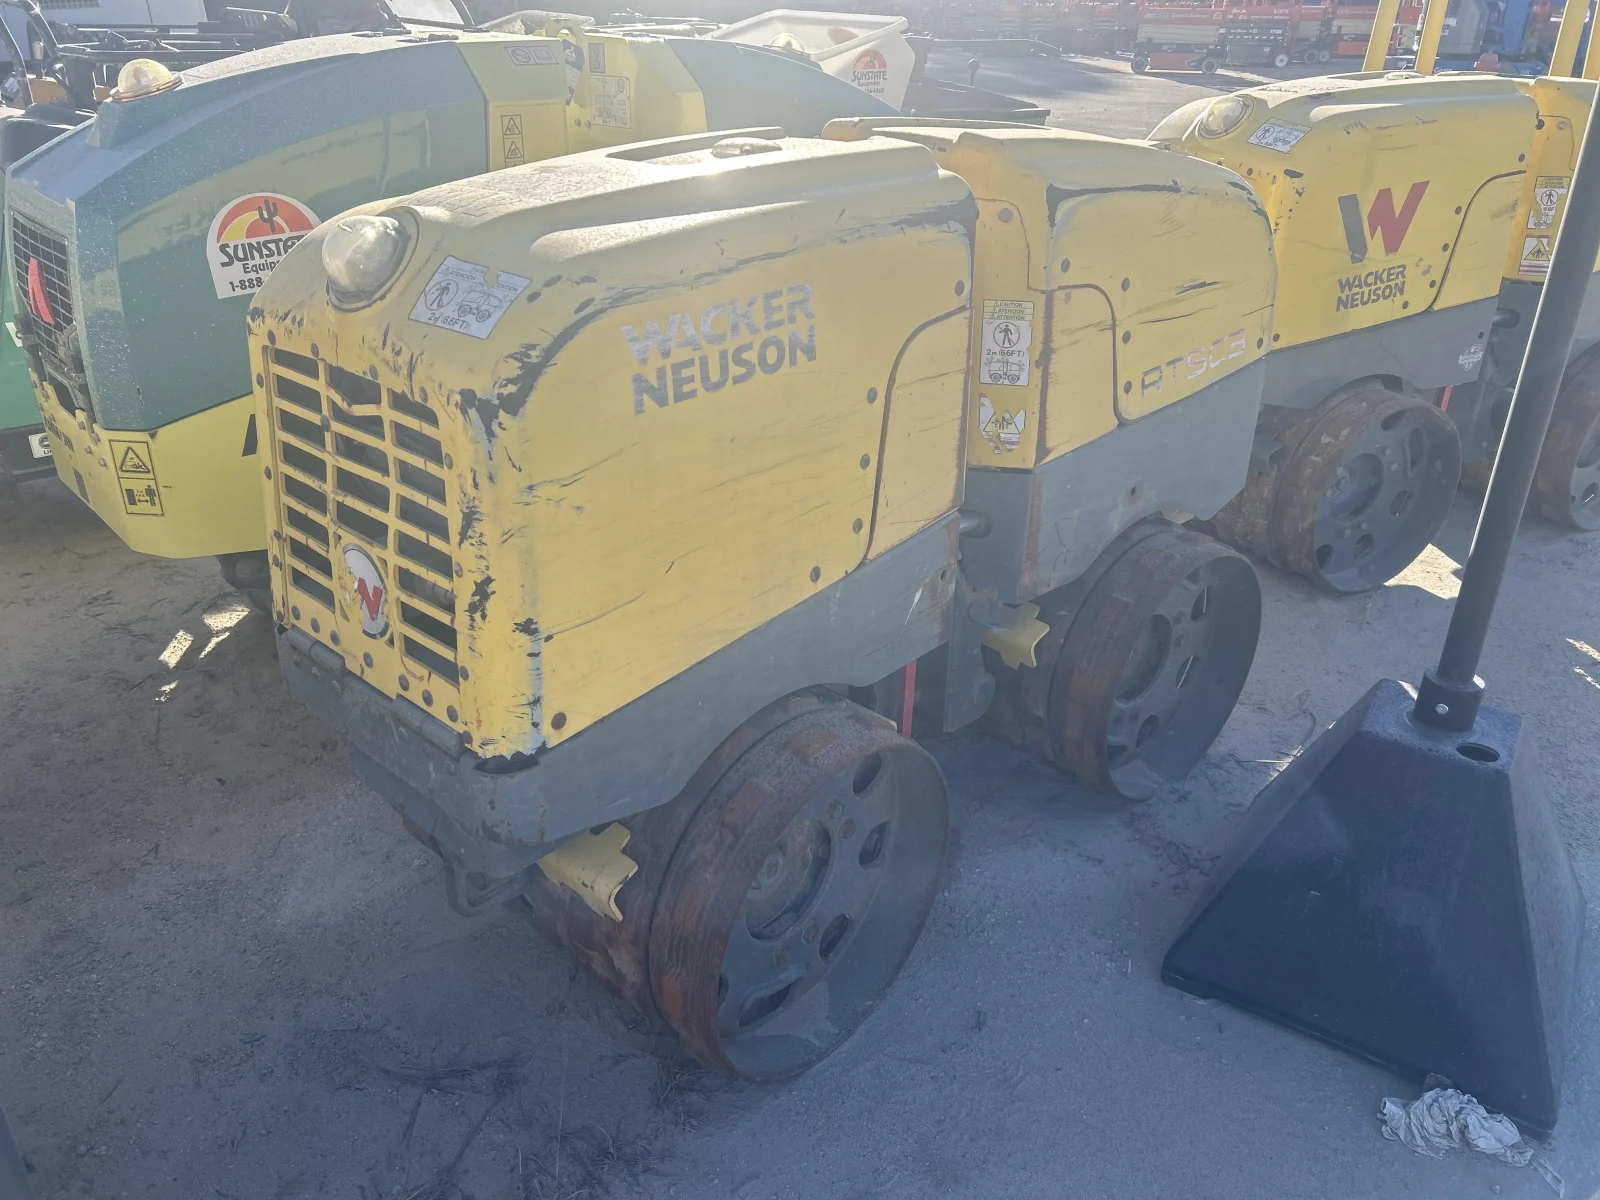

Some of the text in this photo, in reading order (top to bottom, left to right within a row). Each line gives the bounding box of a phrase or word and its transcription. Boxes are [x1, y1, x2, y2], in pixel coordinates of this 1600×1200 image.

[851, 70, 887, 82] SUNSTATE
[219, 235, 307, 267] SUNSTA
[242, 260, 280, 274] Equip
[1338, 264, 1406, 294] WACKER
[1336, 281, 1405, 312] NEUSON
[620, 283, 815, 365] WACKER
[998, 349, 1025, 358] (66FT)
[631, 324, 817, 416] NEUSON
